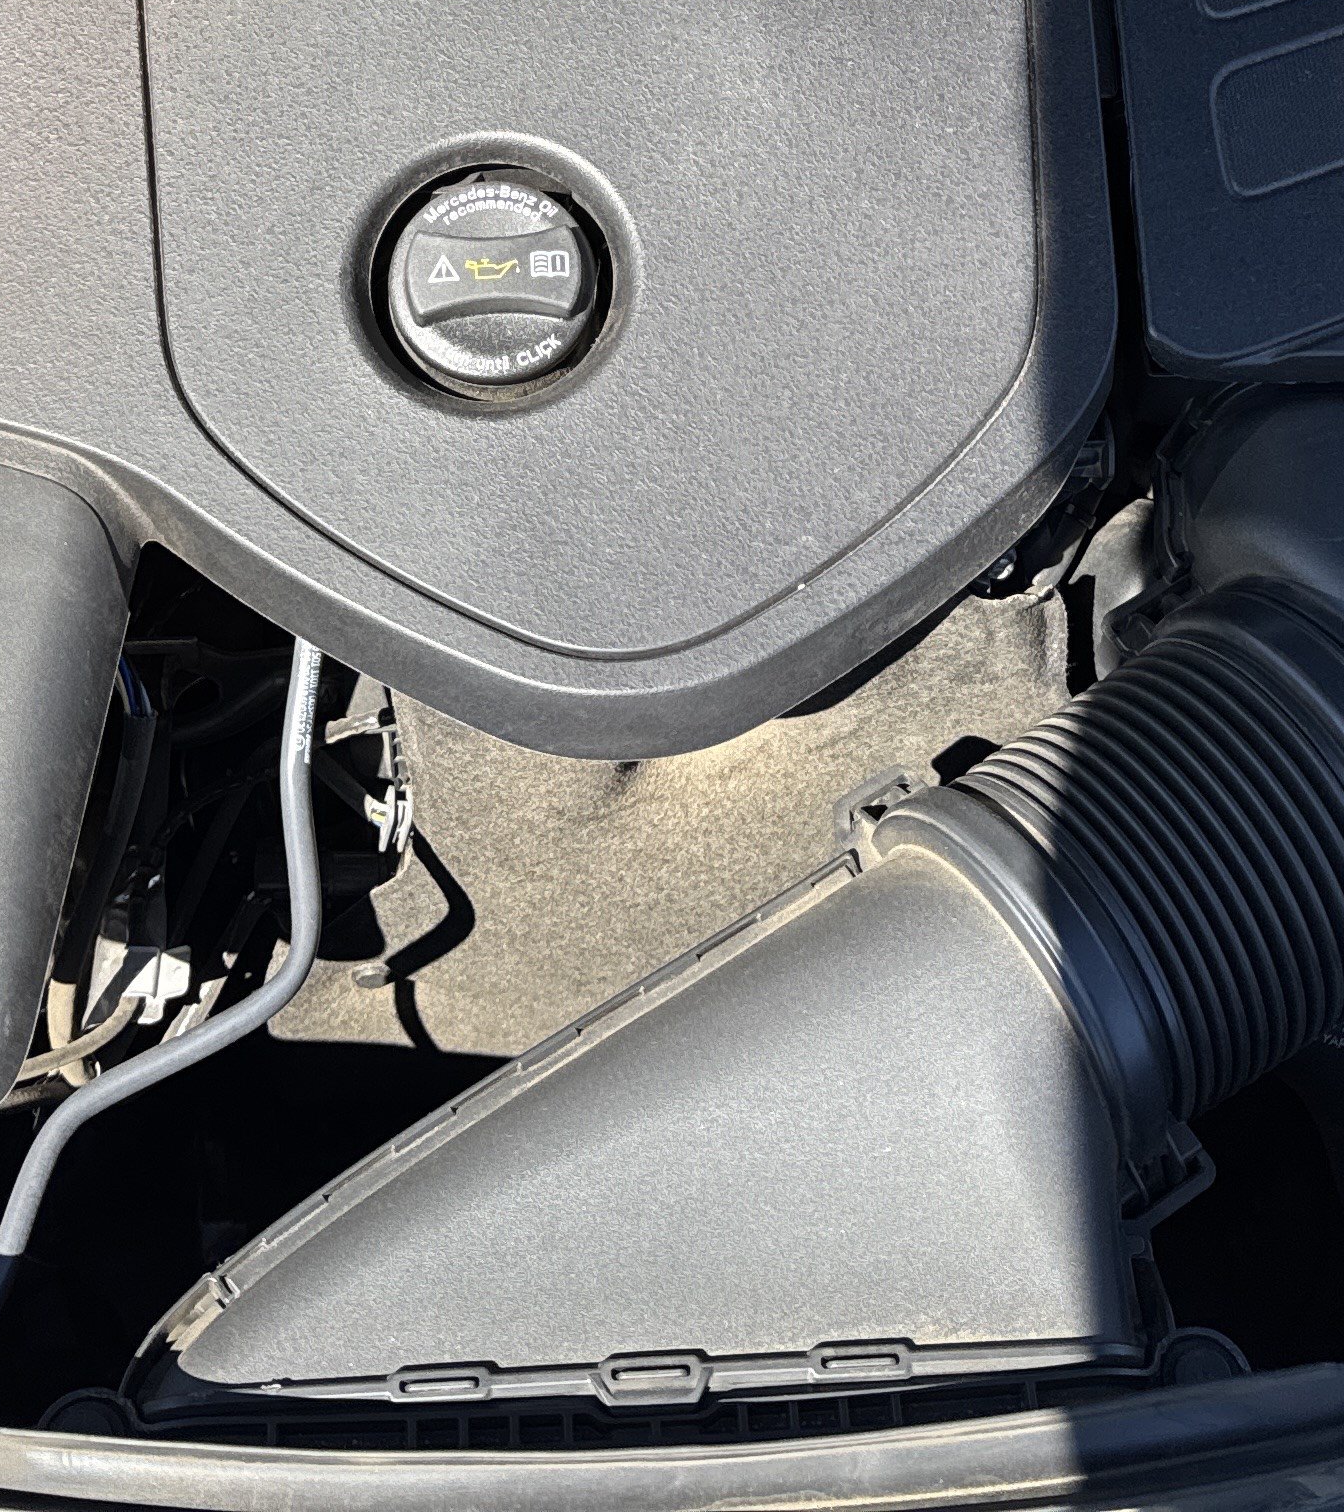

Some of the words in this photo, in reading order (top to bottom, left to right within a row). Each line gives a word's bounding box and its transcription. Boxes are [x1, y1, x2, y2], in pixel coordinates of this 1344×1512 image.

[422, 184, 538, 224] Mercedes-Benz
[539, 200, 560, 218] Oil
[441, 199, 543, 226] recommended
[516, 333, 562, 367] CLICK
